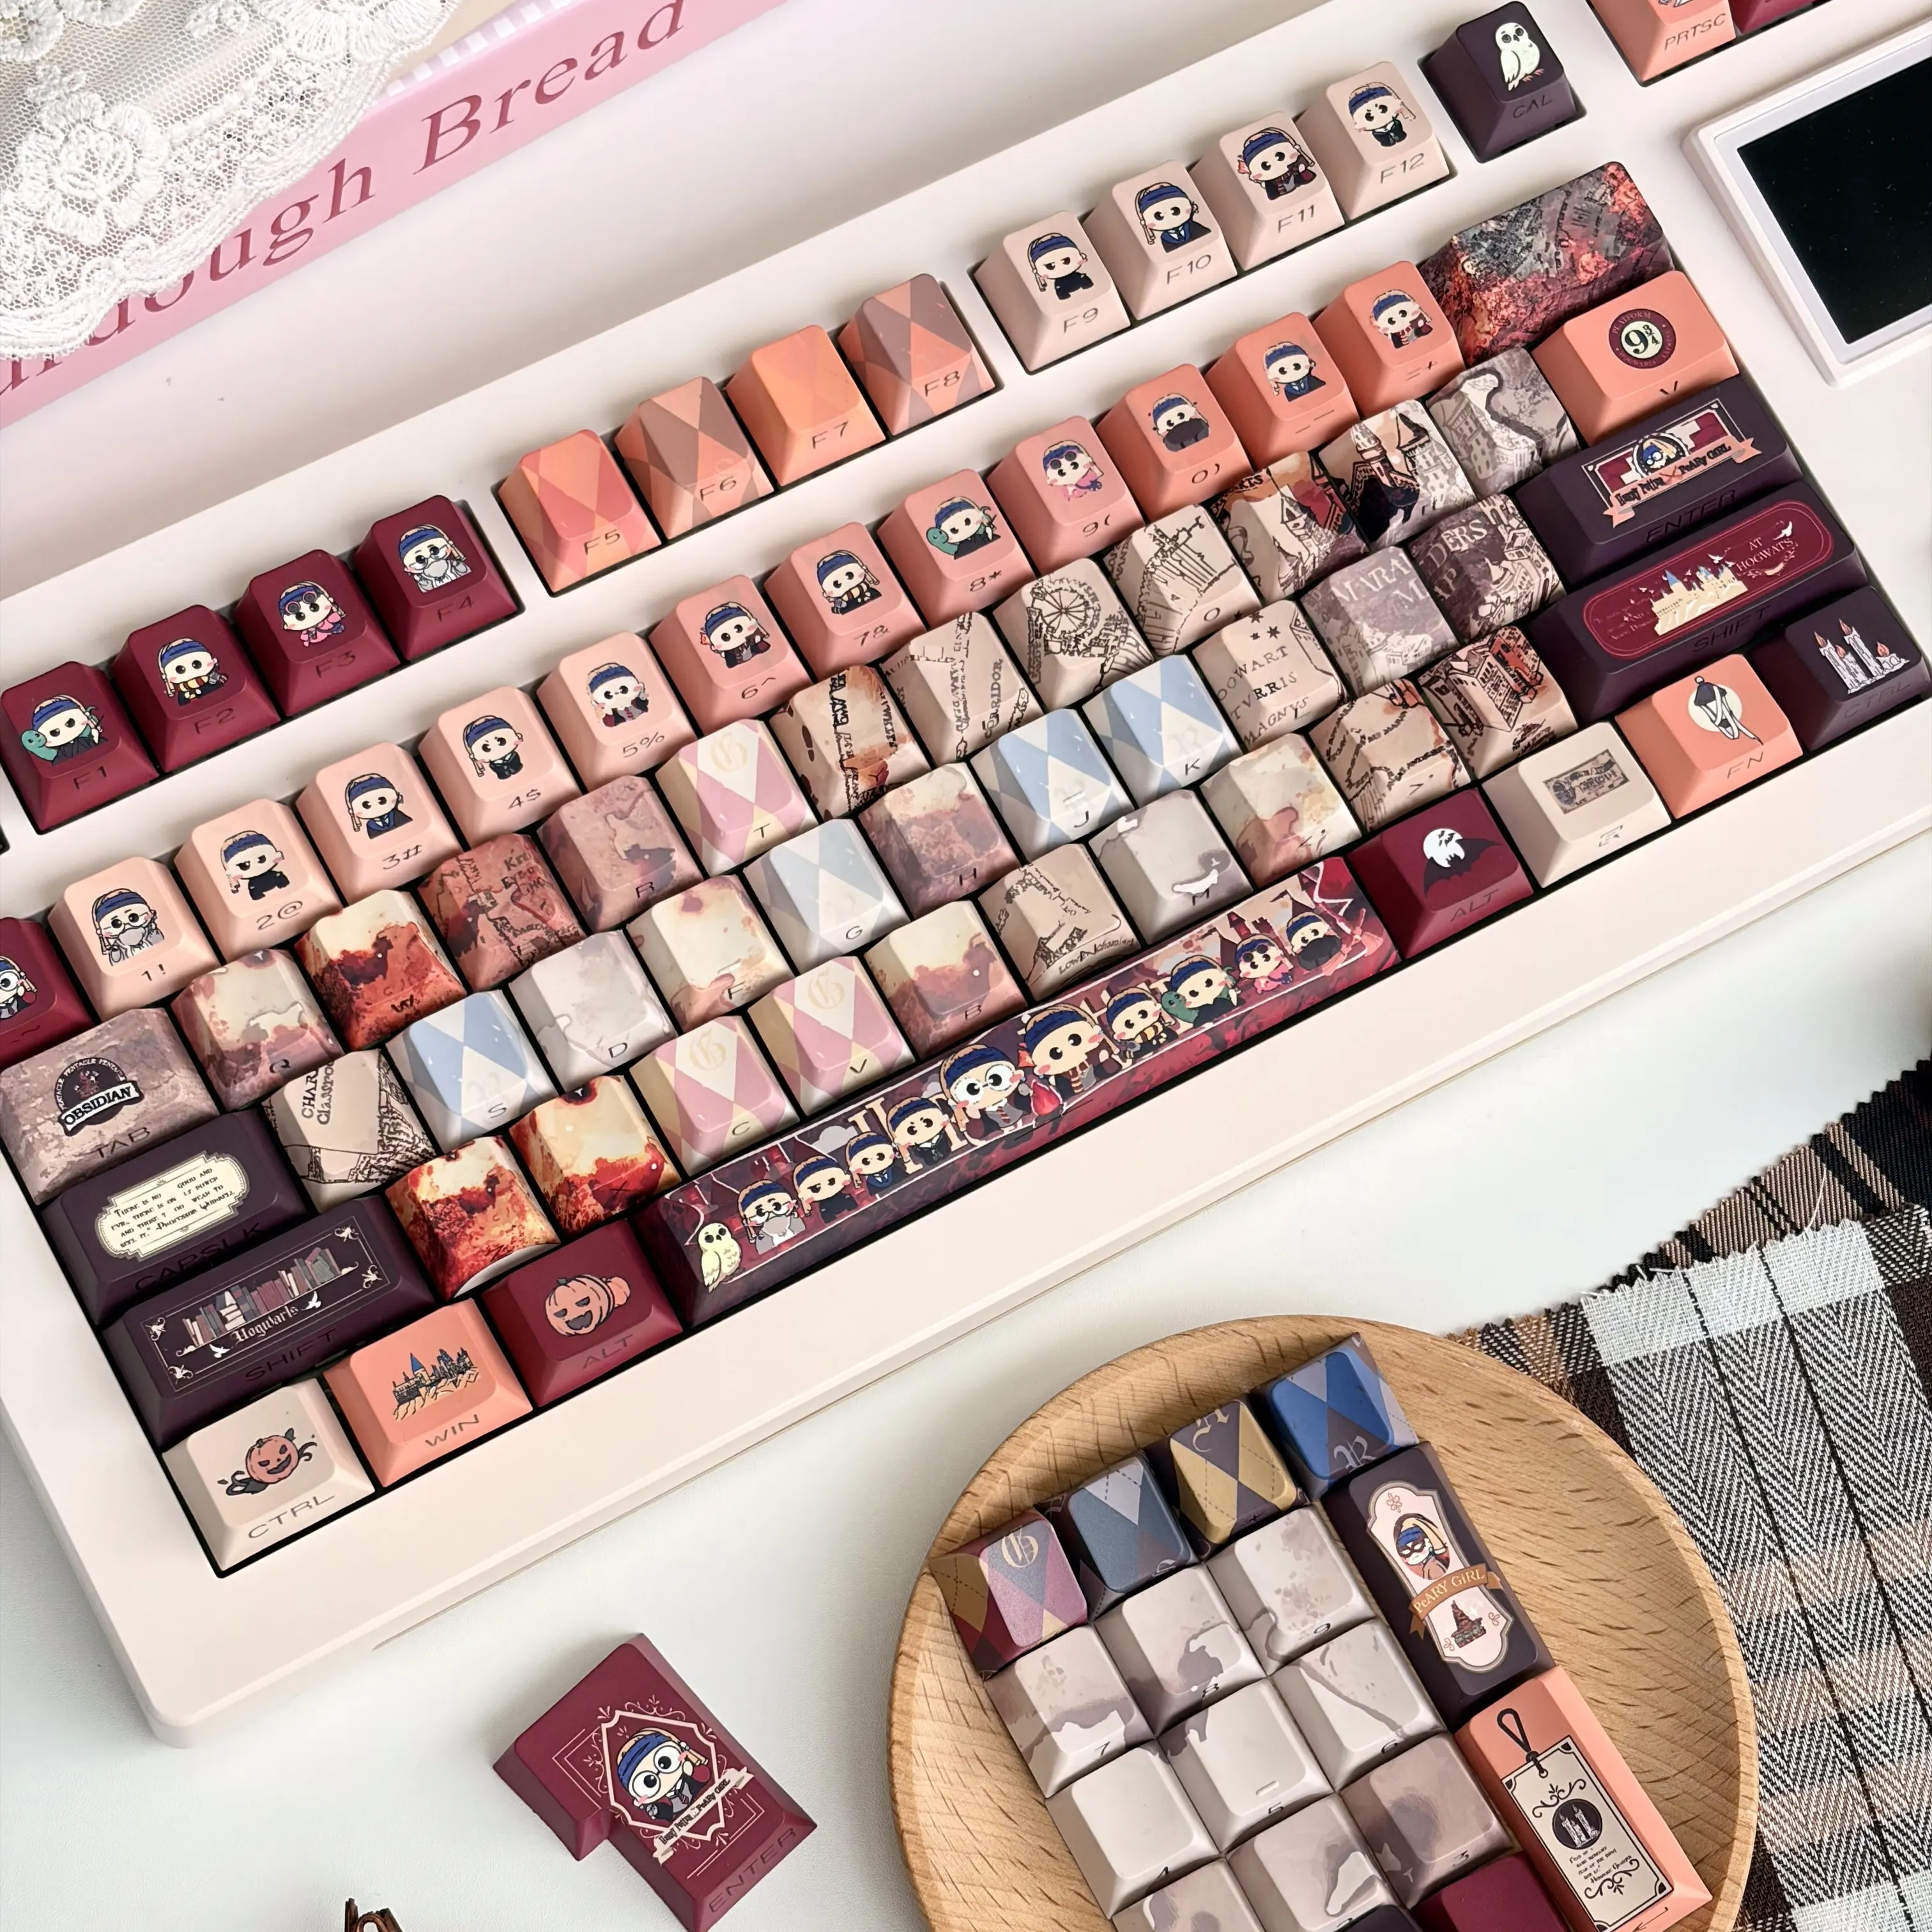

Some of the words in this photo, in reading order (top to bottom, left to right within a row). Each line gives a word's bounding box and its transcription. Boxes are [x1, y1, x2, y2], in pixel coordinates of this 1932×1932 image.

[1664, 13, 1726, 52] PRTSC
[413, 0, 685, 174] Bread
[1512, 95, 1553, 119] CAL
[1381, 153, 1425, 184] F12
[1278, 204, 1315, 233] F11
[1166, 254, 1212, 285] F10
[1063, 307, 1098, 333] F9
[924, 371, 960, 397] F8
[811, 422, 849, 449] F7
[700, 476, 737, 502] F6
[1646, 489, 1736, 542] ENTER
[584, 530, 620, 556] F5
[1748, 537, 1762, 551] AT
[437, 597, 474, 622] F4
[1203, 608, 1220, 623] O
[1692, 605, 1771, 654] SHIFT
[316, 652, 355, 678] F3
[1841, 679, 1912, 721] CTRL
[194, 708, 236, 735] F2
[73, 766, 109, 790] F1
[1184, 758, 1200, 776] K
[1727, 751, 1766, 779] FN
[754, 823, 770, 839] T
[1074, 810, 1090, 827] J
[635, 881, 654, 898] R
[959, 868, 977, 886] H
[256, 901, 303, 932] 2@
[1451, 888, 1501, 923] ALT
[845, 925, 863, 941] G
[728, 986, 744, 1000] F
[965, 1005, 982, 1021] B
[608, 1042, 627, 1058] D
[849, 1058, 868, 1074] V
[63, 1086, 132, 1125] OBSIDIAN
[487, 1103, 507, 1119] S
[731, 1121, 751, 1137] C
[96, 1127, 151, 1158] TAB
[609, 1181, 629, 1198] X
[134, 1222, 261, 1295] CAPSLK
[245, 1327, 337, 1383] SHIFT
[581, 1333, 635, 1370] ALT
[424, 1413, 480, 1447] WIN
[248, 1493, 336, 1540] CTRL
[1314, 1623, 1331, 1635] 9
[1201, 1682, 1220, 1699] 8
[1094, 1741, 1110, 1756] 7
[1268, 1802, 1285, 1816] 5
[709, 1827, 797, 1913] ENTER
[1454, 1850, 1469, 1866] 3
